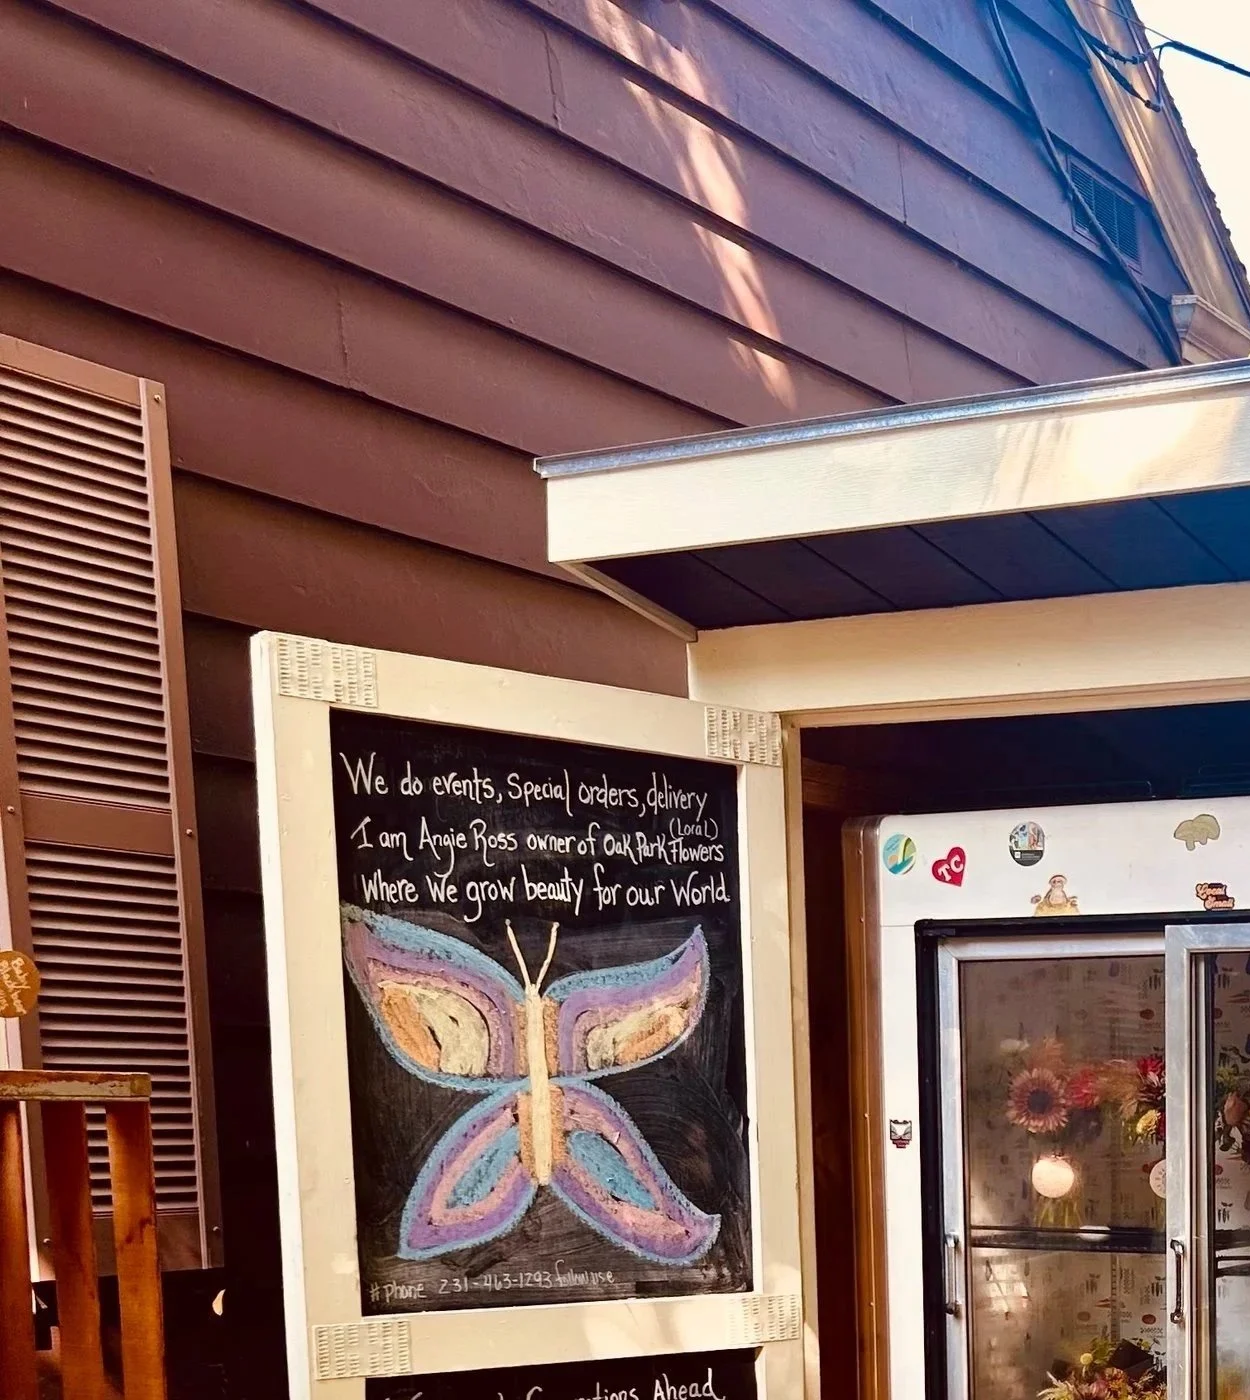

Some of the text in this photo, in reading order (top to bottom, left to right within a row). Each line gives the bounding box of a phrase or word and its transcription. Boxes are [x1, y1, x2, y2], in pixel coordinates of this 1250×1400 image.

[340, 753, 389, 796] We
[400, 761, 423, 797] do
[432, 768, 503, 804] events,
[578, 774, 646, 818] orders,
[647, 772, 708, 821] delivery
[350, 817, 373, 851] I
[379, 832, 414, 862] am
[418, 816, 468, 880] Angie
[469, 818, 519, 867] Ross
[526, 832, 577, 855] owner
[577, 821, 601, 857] of
[667, 837, 724, 864] Flowers
[938, 855, 964, 881] TC
[465, 874, 519, 920] grow
[520, 864, 585, 916] beauty
[593, 862, 622, 912] for
[626, 880, 666, 907] our
